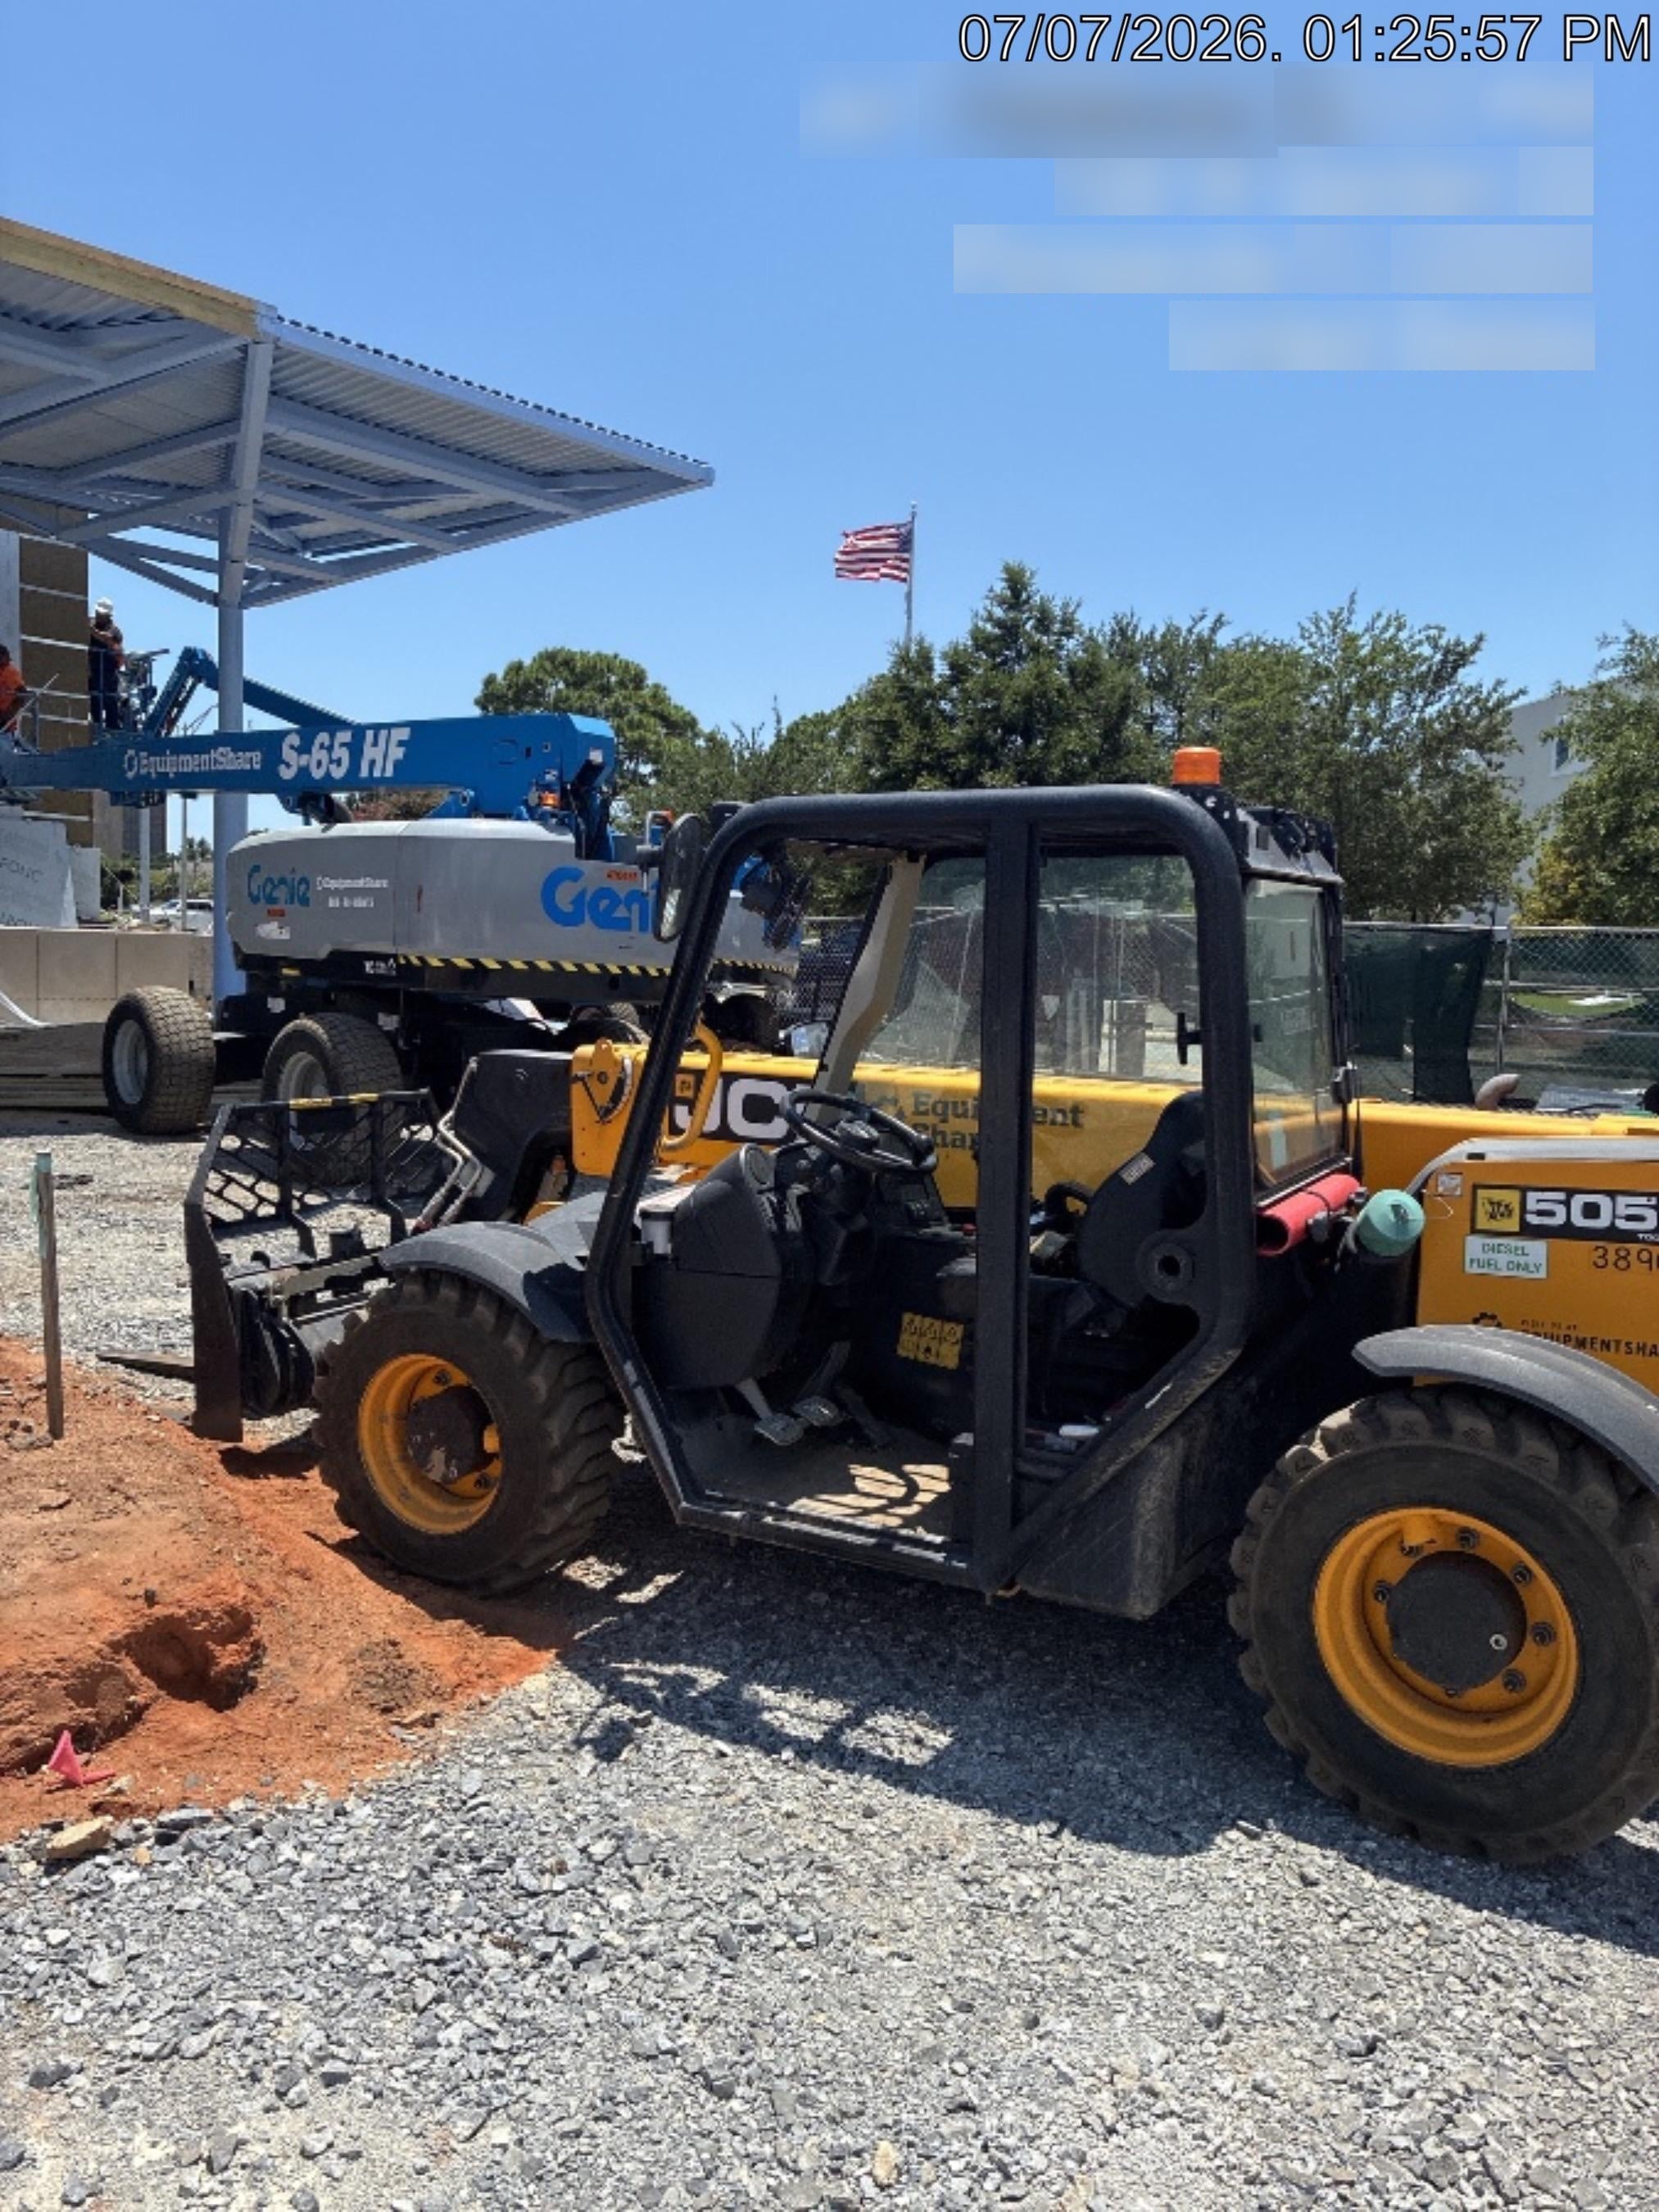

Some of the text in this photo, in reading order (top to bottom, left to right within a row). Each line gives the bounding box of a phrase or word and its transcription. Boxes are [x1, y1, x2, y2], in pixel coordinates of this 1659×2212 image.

[139, 727, 410, 780] EquipmentShare S-65 HF
[247, 864, 310, 907] Genie
[1525, 1191, 1657, 1230] 505
[1481, 1242, 1530, 1257] DIESEL
[1592, 1245, 1659, 1271] 389
[1469, 1258, 1543, 1274] FUEL ONLY
